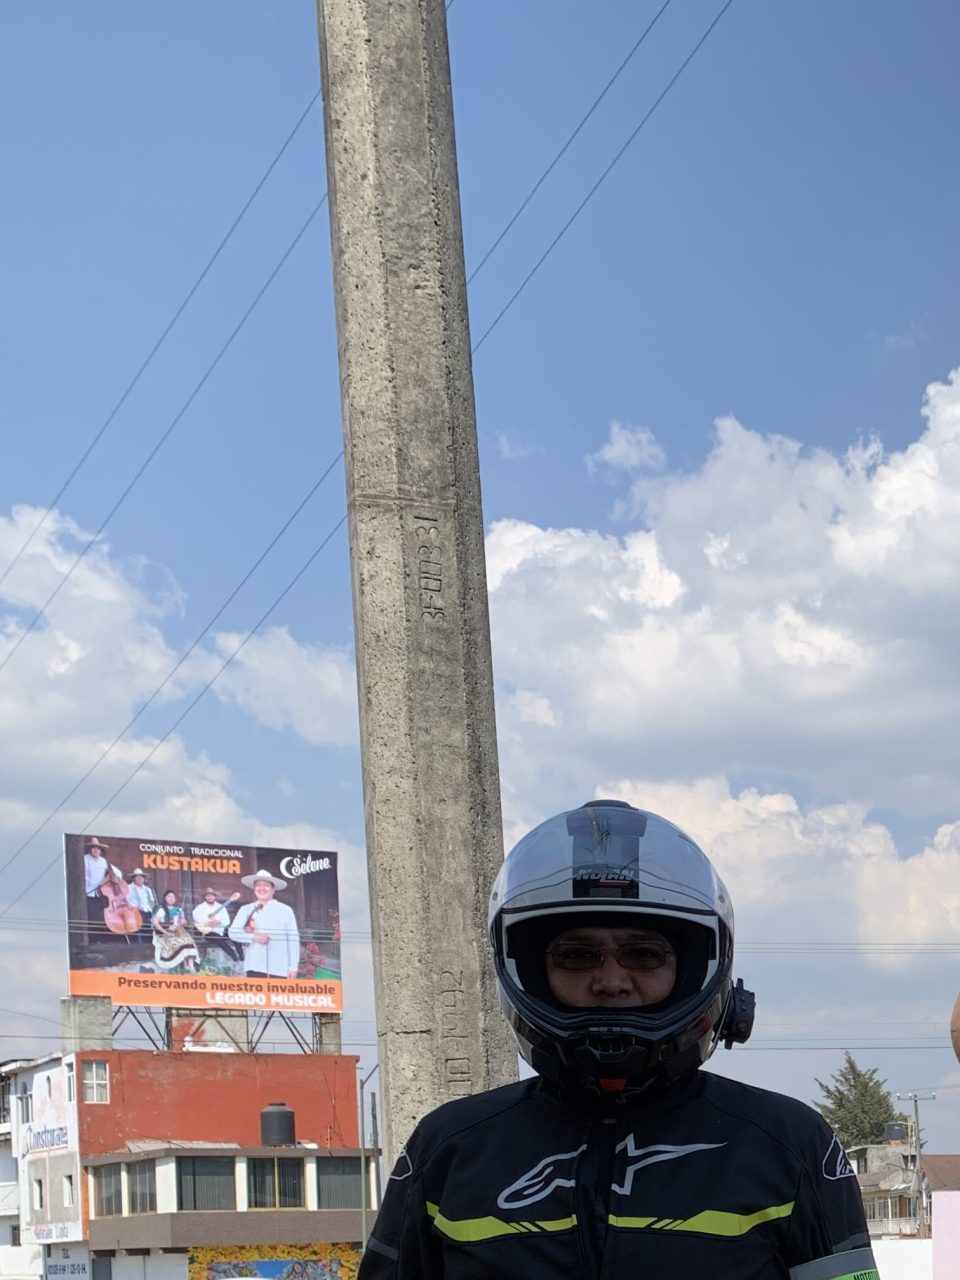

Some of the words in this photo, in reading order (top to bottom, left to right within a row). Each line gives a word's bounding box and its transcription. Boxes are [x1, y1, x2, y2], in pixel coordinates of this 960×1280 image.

[139, 843, 184, 855] CONJUNTO
[190, 847, 244, 858] TRADICIONAL
[143, 854, 241, 874] KUSTAKUA
[291, 853, 331, 876] Selene
[117, 976, 207, 991] Preservando
[210, 982, 263, 992] nuestro
[267, 981, 336, 995] invaluable
[205, 992, 266, 1006] LEGADO
[270, 993, 336, 1008] MUSICAL
